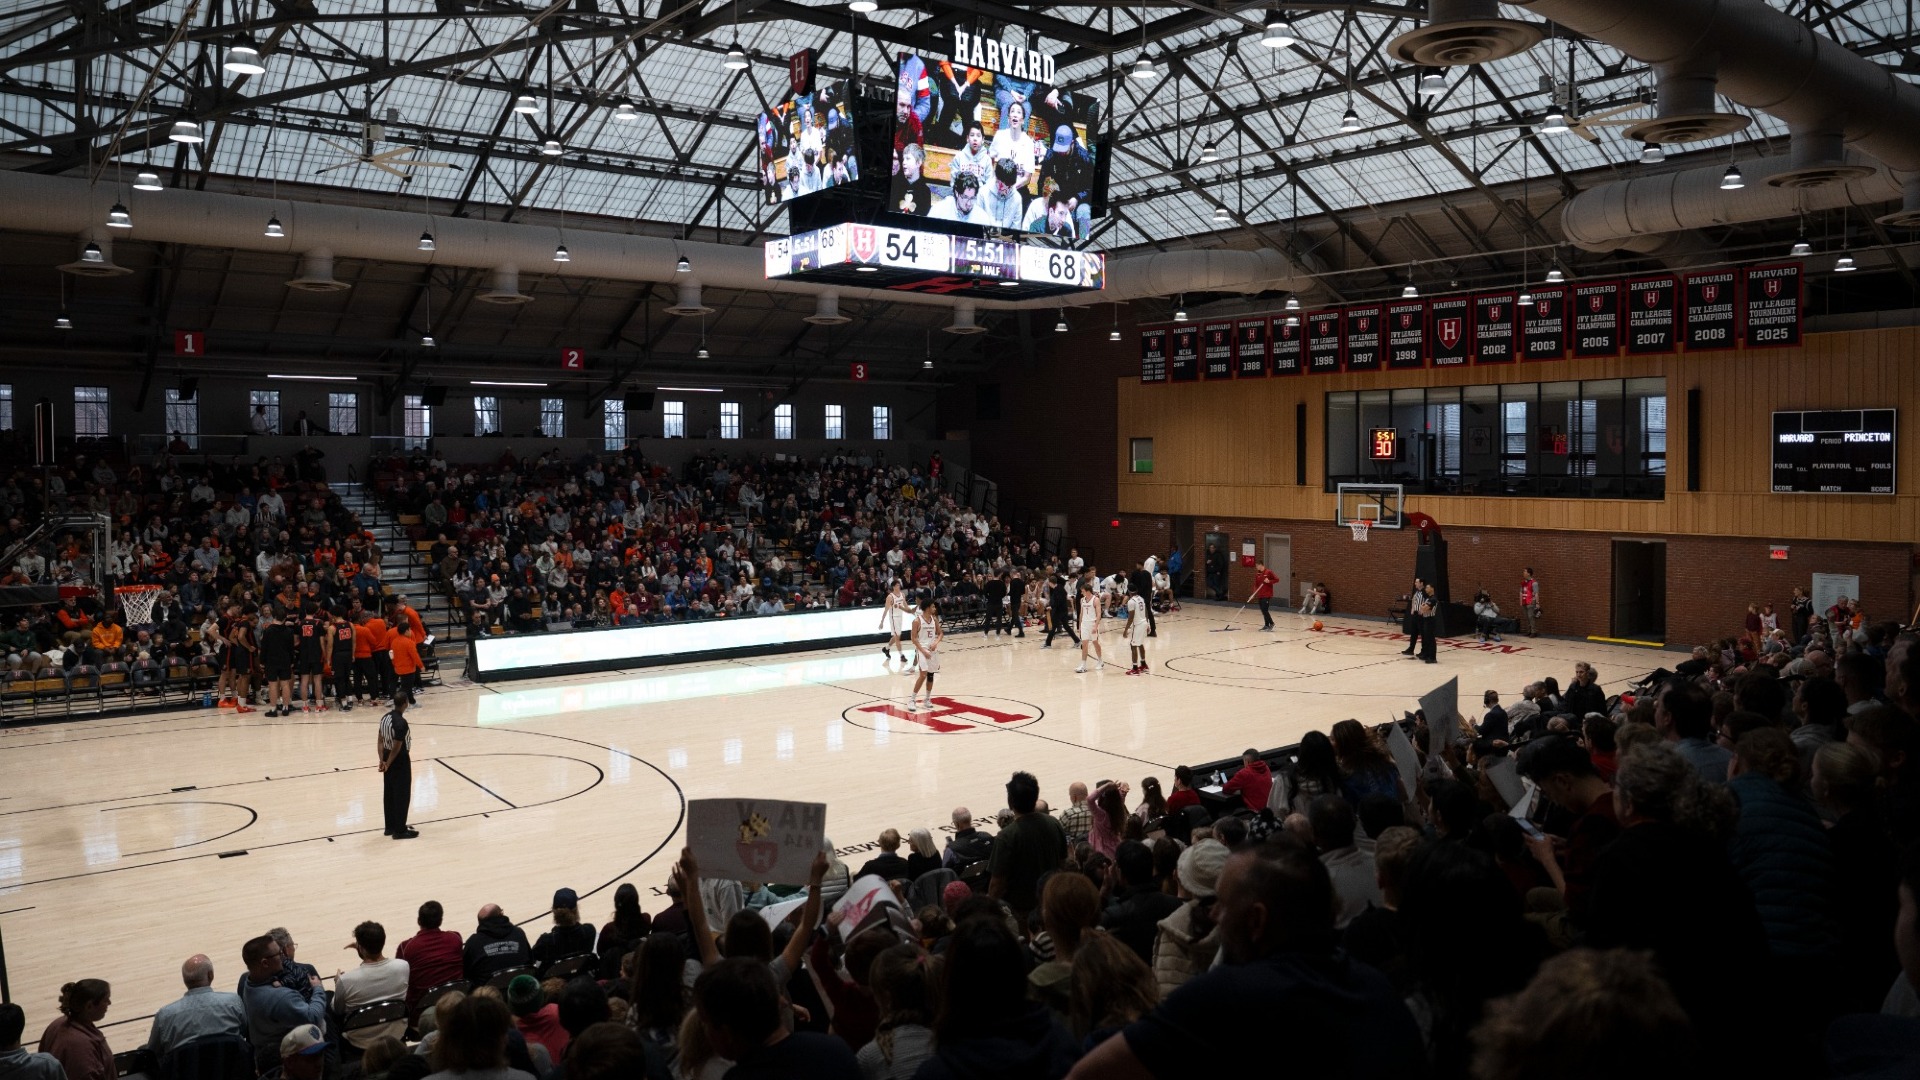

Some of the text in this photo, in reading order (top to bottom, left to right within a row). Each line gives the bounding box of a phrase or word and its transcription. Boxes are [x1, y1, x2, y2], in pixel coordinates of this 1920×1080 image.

[955, 31, 1054, 86] HARVARD
[795, 56, 804, 83] H
[822, 230, 834, 248] 68
[856, 230, 872, 251] H
[778, 240, 788, 258] 54
[886, 233, 918, 263] 54
[966, 240, 1004, 263] 5:51
[982, 266, 1000, 276] HALF
[1049, 253, 1076, 280] 68
[1750, 268, 1797, 279] HARVARD
[1688, 274, 1733, 285] HARVARD
[1631, 280, 1673, 290] HARVARD
[1577, 286, 1616, 295] HARVARD
[1433, 300, 1466, 309] HARVARD
[1478, 296, 1512, 305] HARVARD
[1750, 299, 1796, 309] IVY LEAGUE
[1349, 309, 1378, 317] HARVARD
[1390, 305, 1422, 313] HARVARD
[1645, 309, 1672, 318] LEAGUE
[1689, 304, 1732, 314] IVY LEAGUE
[1750, 307, 1796, 317] TOURNAMENT
[1310, 313, 1338, 321] HARVARD
[1631, 318, 1672, 326] CHAMPIONS
[1688, 312, 1733, 322] CHAMPIONS
[1749, 316, 1796, 326] CHAMPIONS
[1525, 326, 1562, 334] CHAMPIONS
[1577, 322, 1616, 330] CHAMPIONS
[1477, 330, 1511, 338] CHAMPIONS
[1637, 333, 1665, 344] 2007
[1695, 328, 1726, 340] 2008
[1757, 328, 1788, 340] 2025
[184, 334, 195, 352] 1
[1390, 337, 1422, 345] CHAMPIONS
[1531, 341, 1556, 351] 2003
[1583, 337, 1609, 348] 2005
[1483, 345, 1506, 354] 2002
[568, 351, 578, 367] 2
[1353, 353, 1373, 363] 1997
[1396, 351, 1416, 360] 1998
[1243, 362, 1260, 370] 1988
[1278, 359, 1295, 368] 1991
[1315, 356, 1334, 366] 1996
[1436, 357, 1463, 365] WOMEN
[856, 365, 864, 378] 3
[1210, 364, 1226, 372] 1986
[1377, 432, 1394, 440] 5:51
[1780, 434, 1814, 443] HARVARD
[1844, 433, 1891, 442] PRINCETON
[1376, 441, 1391, 456] 30
[302, 625, 313, 637] 15
[339, 628, 351, 640] 23
[858, 696, 1033, 733] H
